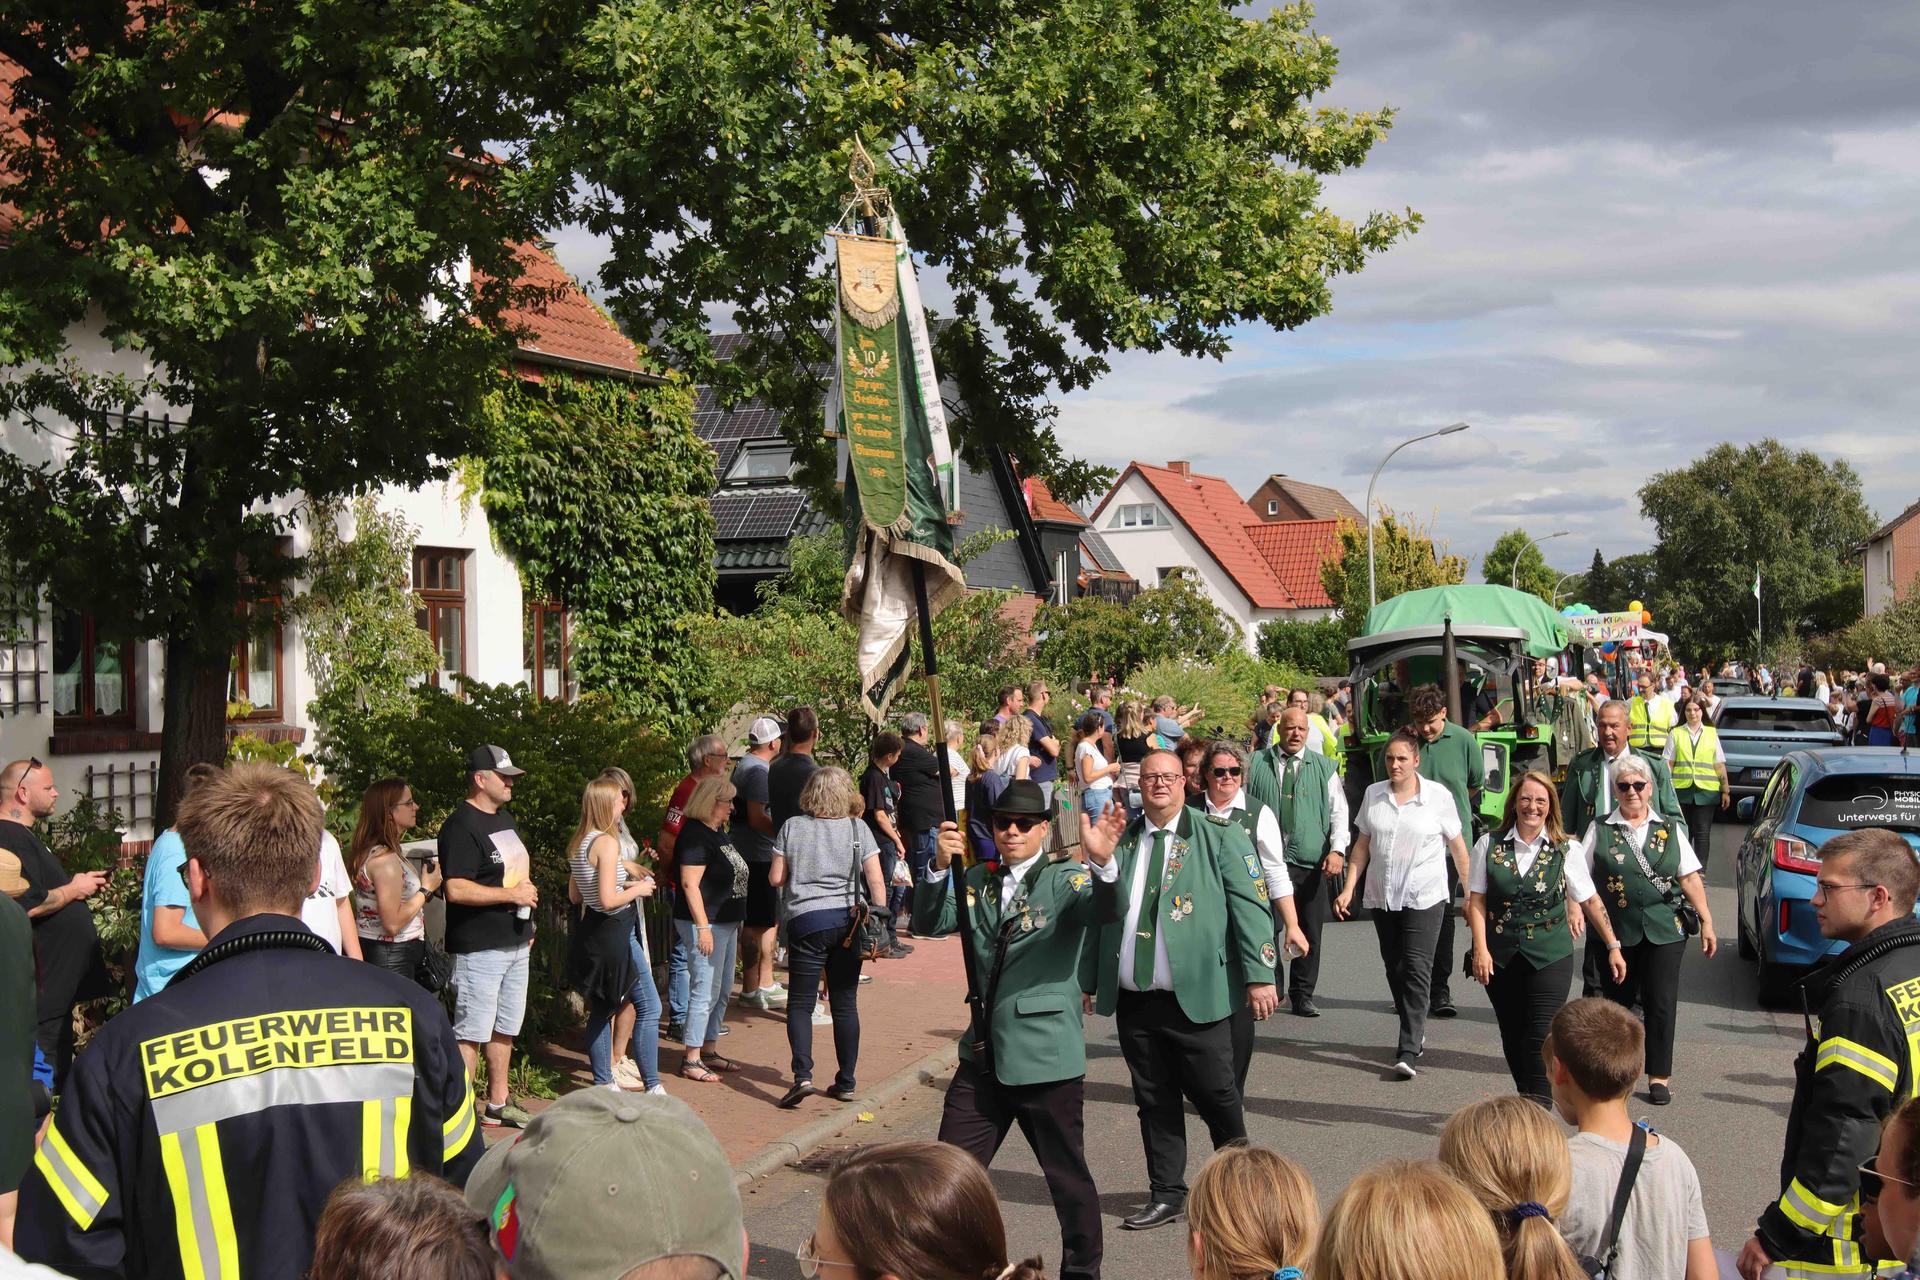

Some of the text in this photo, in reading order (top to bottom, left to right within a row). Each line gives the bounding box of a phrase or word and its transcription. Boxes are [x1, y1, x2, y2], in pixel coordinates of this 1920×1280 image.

[863, 351, 876, 364] 10
[1601, 625, 1638, 639] NOAH
[1838, 813, 1898, 822] Unterwegs
[1900, 811, 1916, 821] für
[146, 1011, 407, 1065] FEUERWEHR
[150, 1038, 409, 1094] KOLENFELD
